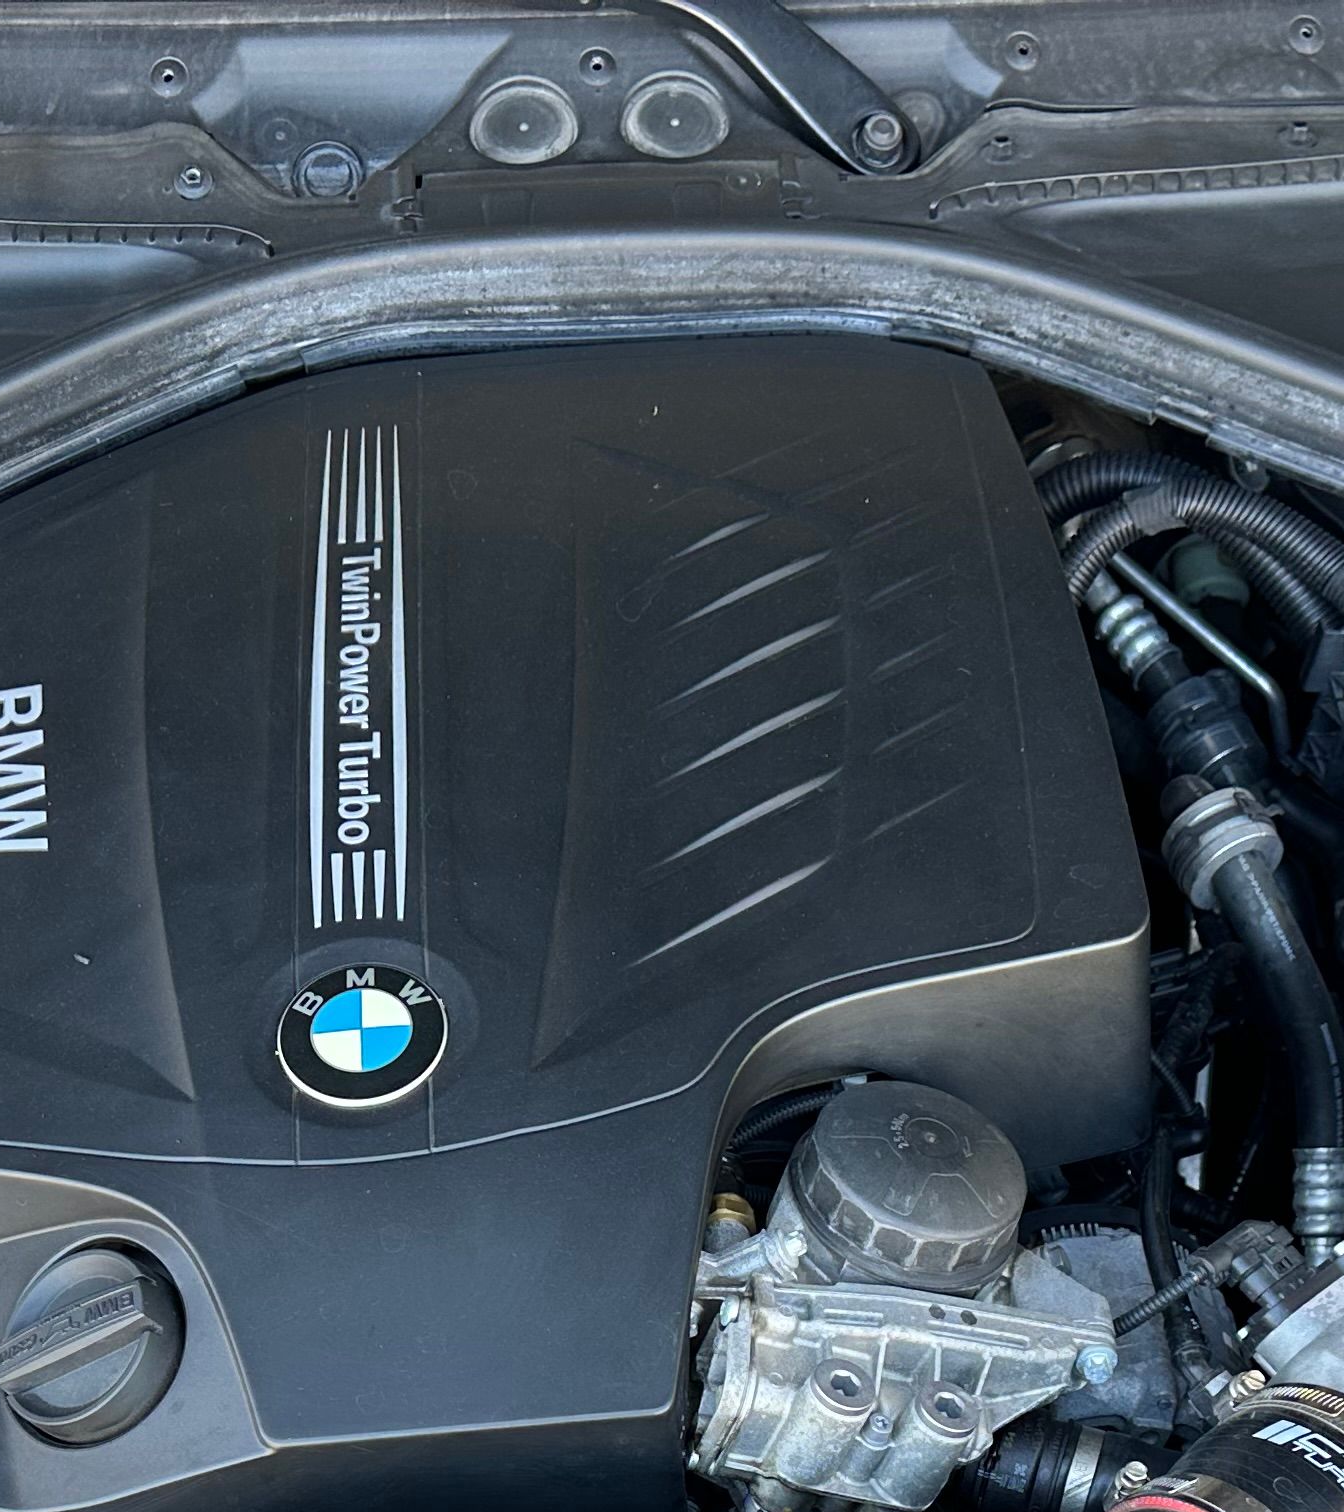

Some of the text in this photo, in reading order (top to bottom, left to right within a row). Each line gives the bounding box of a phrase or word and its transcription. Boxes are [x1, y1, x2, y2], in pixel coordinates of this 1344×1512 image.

[334, 547, 382, 846] TwinPower Turbo
[292, 966, 432, 1017] BMW
